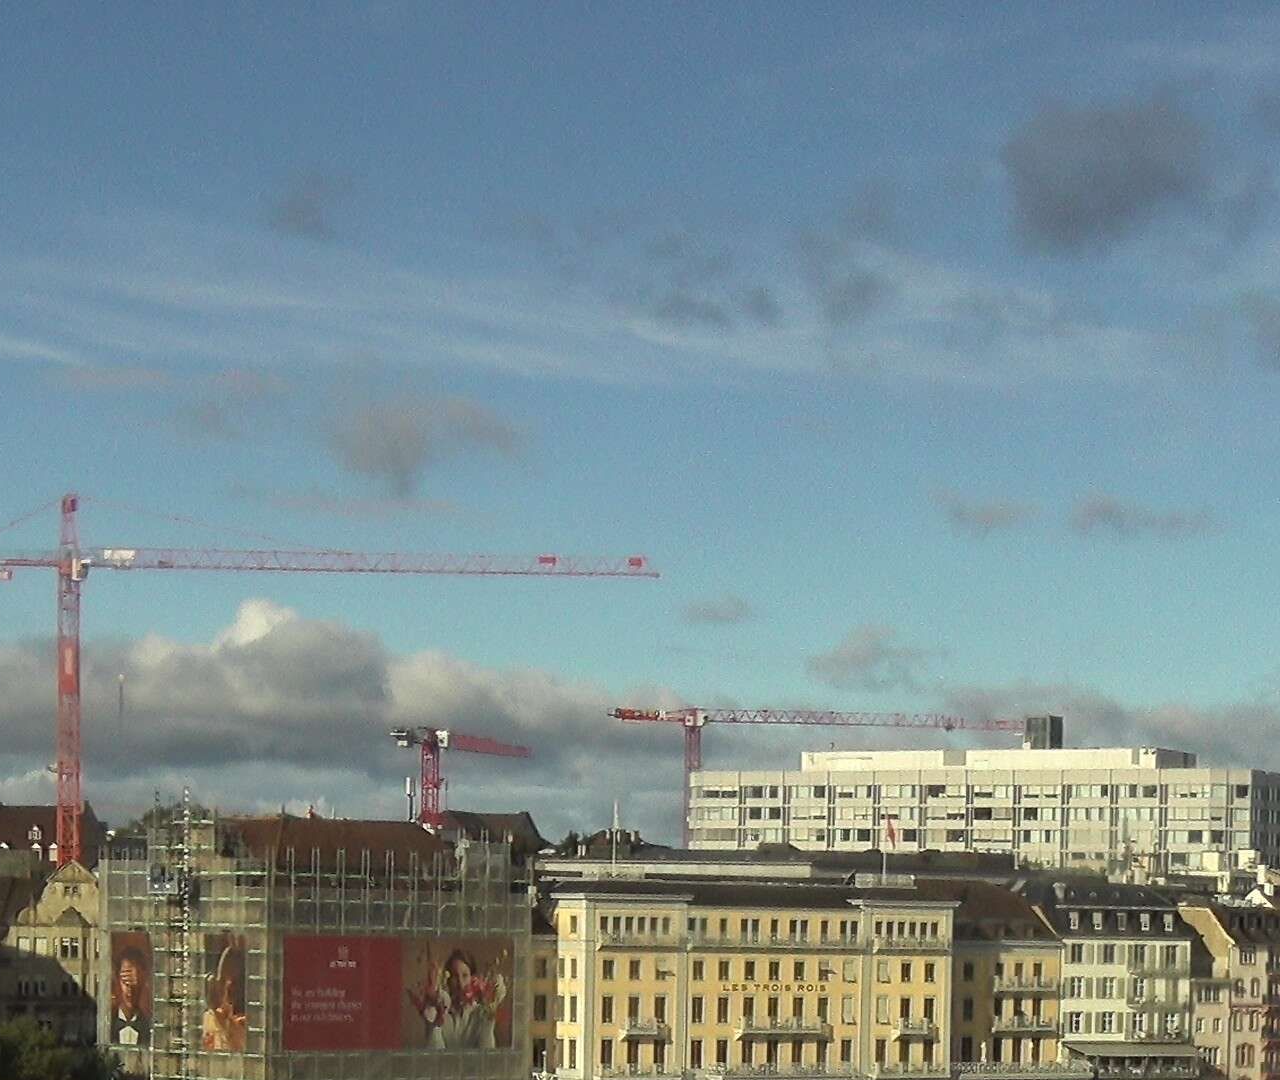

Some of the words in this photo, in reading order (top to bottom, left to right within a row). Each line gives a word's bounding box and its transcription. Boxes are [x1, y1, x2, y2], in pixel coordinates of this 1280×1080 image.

[722, 983, 748, 992] LES
[753, 983, 792, 992] TROIS
[797, 983, 827, 992] ROIS
